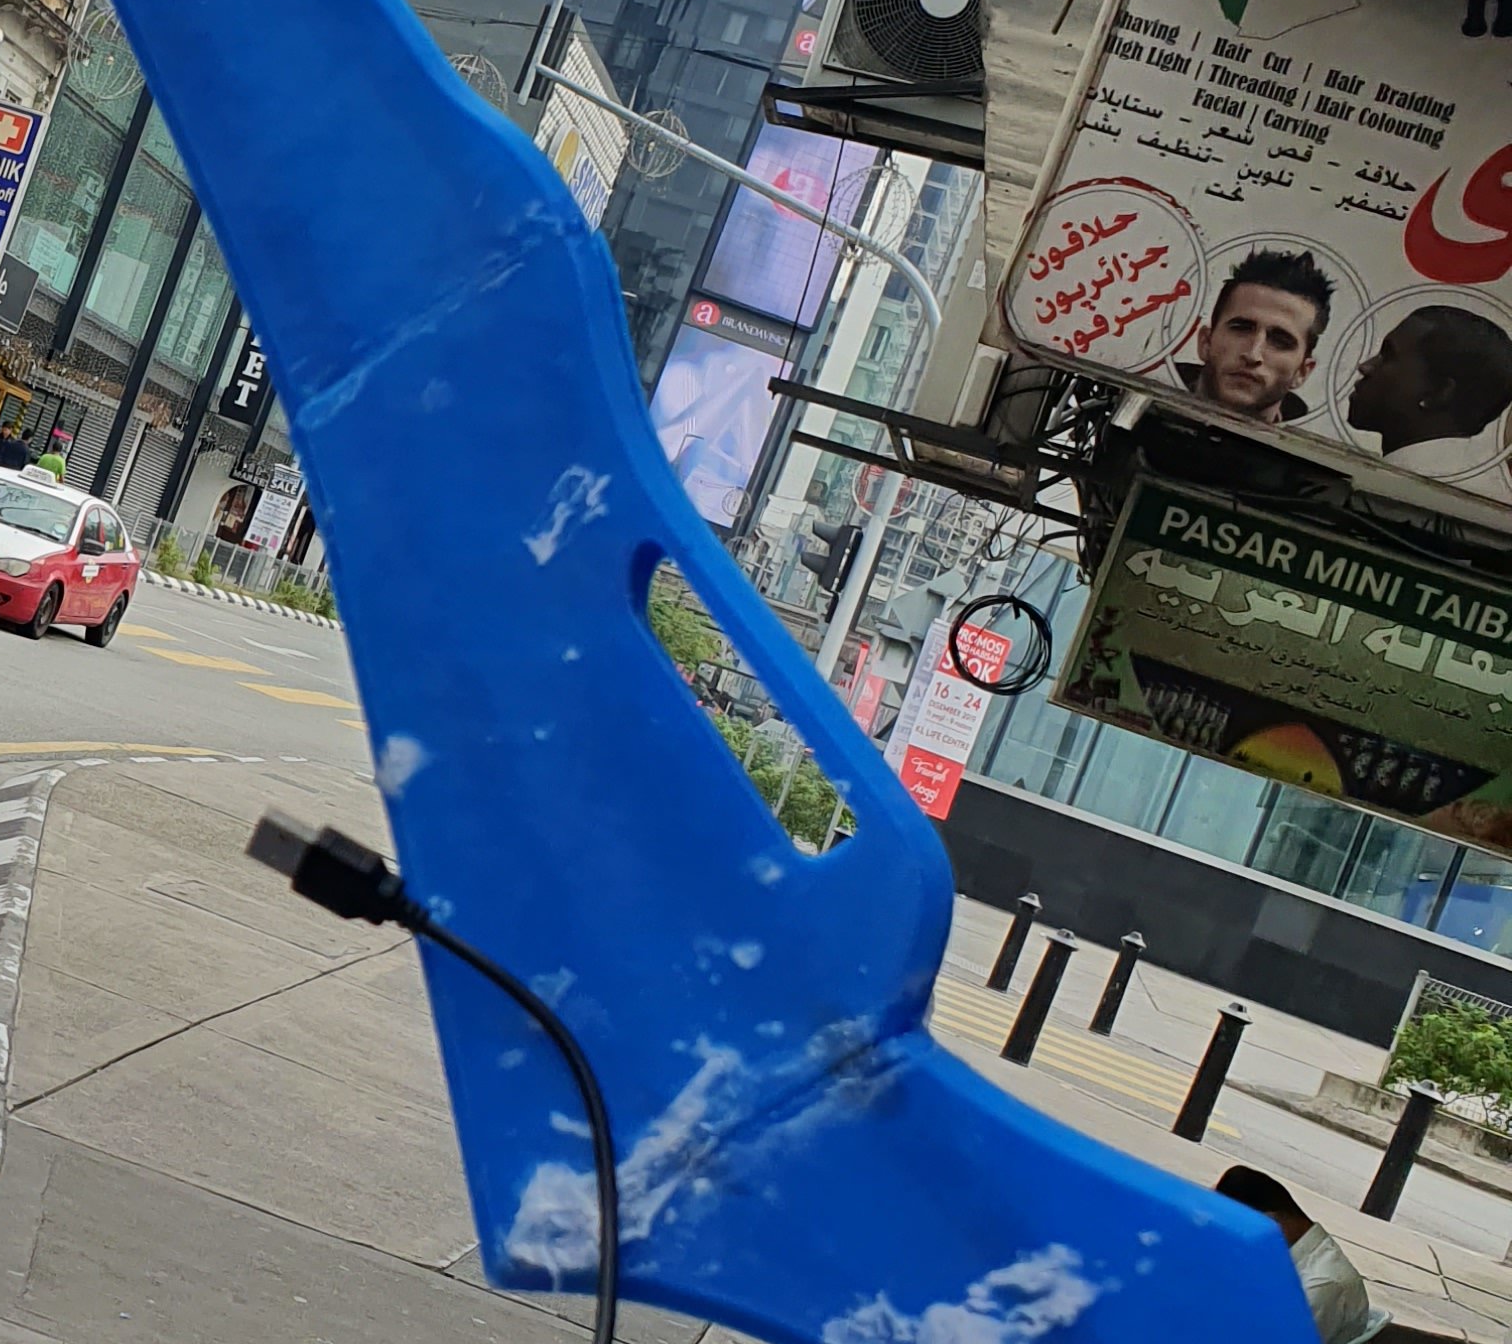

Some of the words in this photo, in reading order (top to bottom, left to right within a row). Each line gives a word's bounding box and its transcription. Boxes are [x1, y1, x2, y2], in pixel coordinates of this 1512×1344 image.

[1145, 45, 1192, 75] Light
[1208, 64, 1300, 108] Threading
[1313, 94, 1354, 123] Hair
[1357, 107, 1445, 151] Colouring
[1211, 36, 1253, 65] Hair
[1262, 50, 1292, 75] Cut
[1323, 68, 1366, 97] Hair
[1373, 81, 1456, 125] Braiding
[1191, 86, 1247, 119] Facial
[1263, 107, 1332, 146] Carving
[1201, 122, 1255, 146] شعر
[1266, 143, 1313, 164] قص
[1353, 158, 1418, 193] حلاقة
[1027, 211, 1139, 281] حلاقون
[1035, 244, 1170, 324] جزائريون
[1052, 278, 1192, 357] محترفون
[270, 478, 298, 496] SALE
[1158, 504, 1299, 574] PASAR
[1303, 548, 1406, 608] MINI
[958, 626, 1006, 654] ROMOSI
[928, 699, 962, 718] DISEMBER
[933, 681, 951, 699] 16
[963, 692, 983, 712] 24
[941, 734, 971, 752] CENTRE
